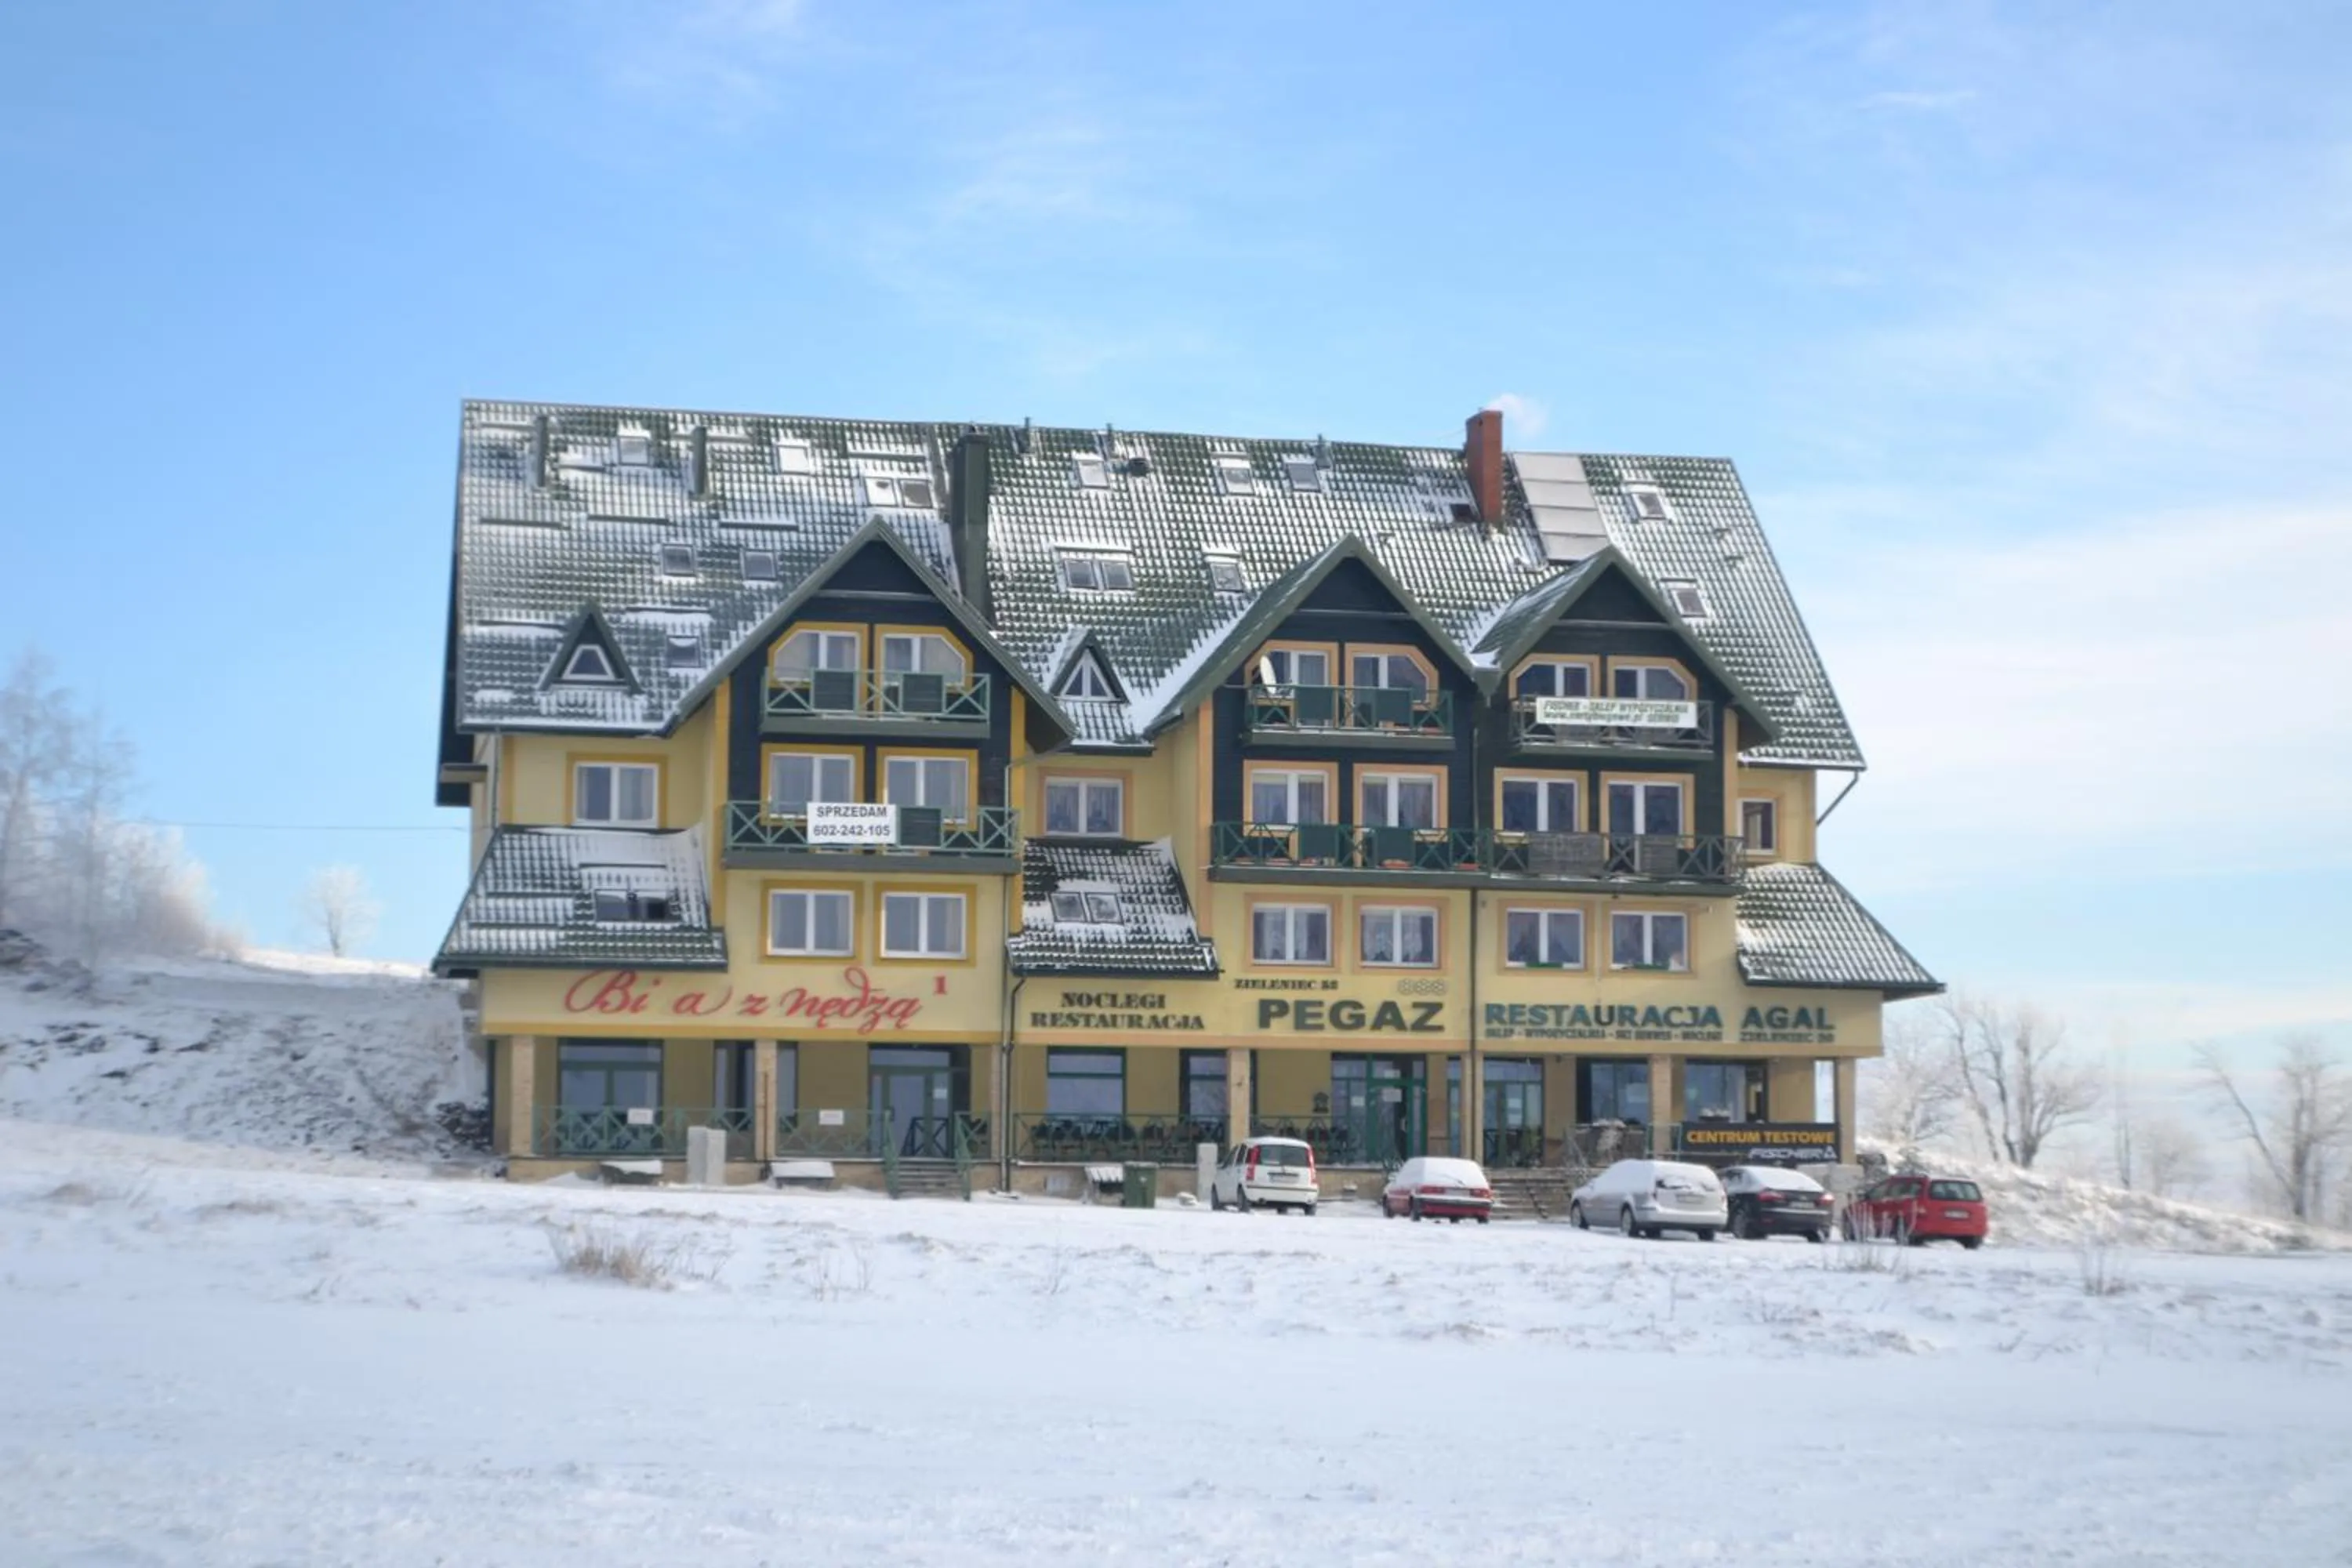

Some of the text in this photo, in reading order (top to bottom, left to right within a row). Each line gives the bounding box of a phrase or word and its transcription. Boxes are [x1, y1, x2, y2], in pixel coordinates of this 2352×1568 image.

[816, 806, 887, 818] SPRZEDAM
[813, 824, 891, 837] 602-242-105
[735, 993, 770, 1016] z
[779, 966, 923, 1036] nędzą
[1061, 991, 1167, 1010] NOCLEGI
[1030, 1011, 1206, 1030] RESTAURACJA
[1258, 998, 1445, 1033] PEGAZ
[1484, 1003, 1836, 1030] RESTAURACJA AGAL
[1686, 1130, 1835, 1144] CENTRUM TESTOWE
